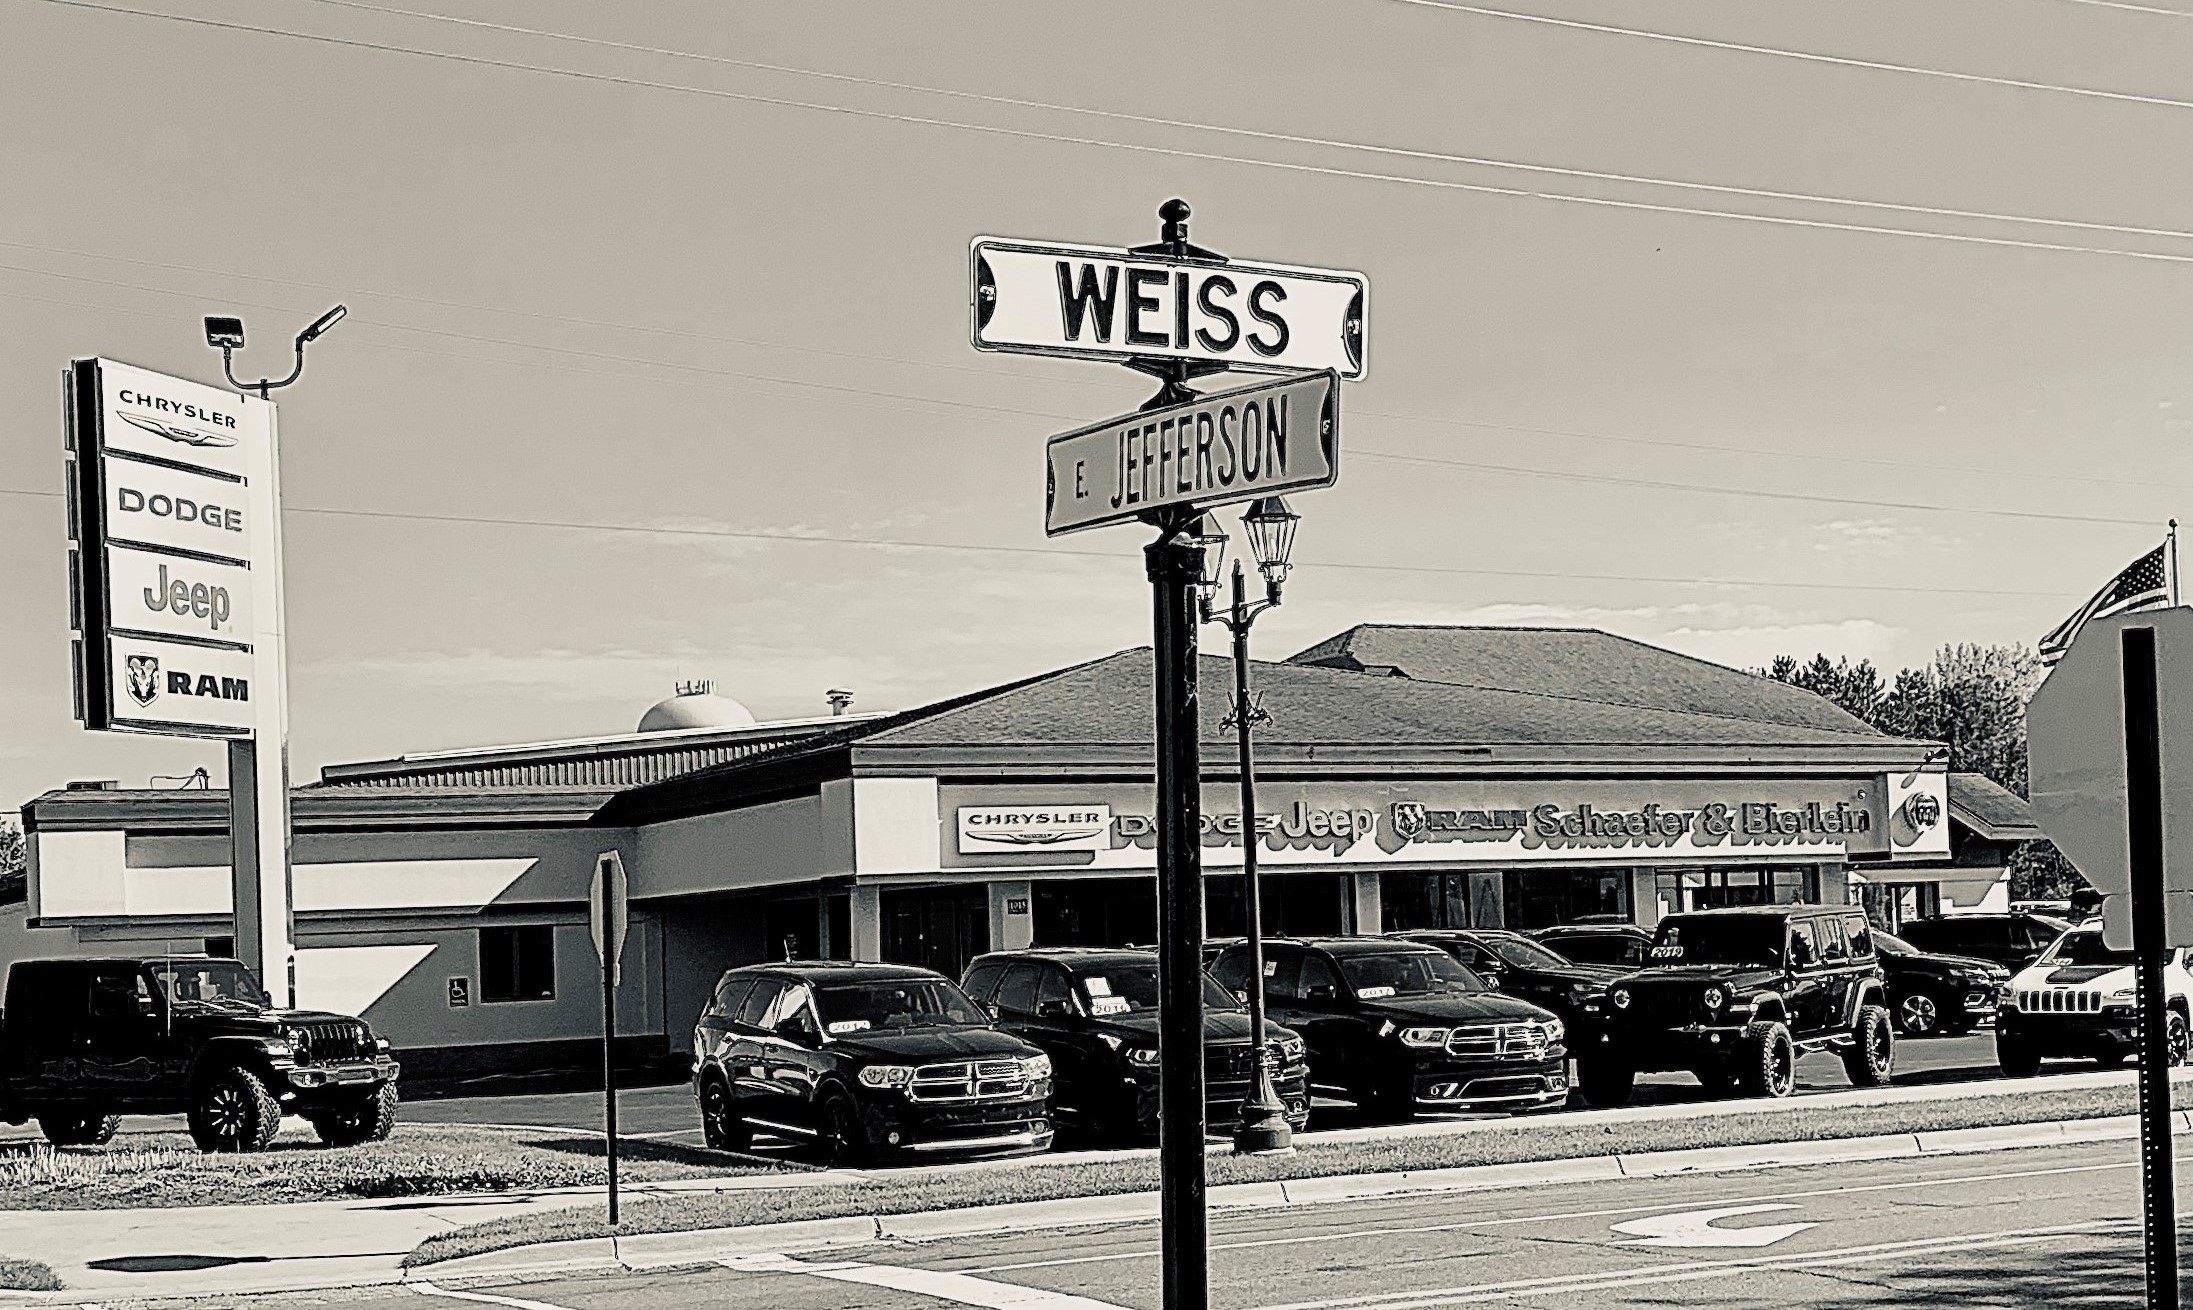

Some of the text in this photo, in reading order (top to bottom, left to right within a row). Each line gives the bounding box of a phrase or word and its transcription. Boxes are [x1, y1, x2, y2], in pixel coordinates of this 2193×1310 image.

[1055, 260, 1290, 357] WEISS
[118, 389, 237, 429] CHRYSLER
[1075, 394, 1288, 509] E. JEFFERSON
[118, 487, 243, 532] DODGE
[143, 564, 230, 630] Jeep
[167, 671, 249, 702] RAM
[968, 812, 1100, 825] CHRYSLER
[1117, 801, 1870, 841] DGE Jeep RAM Schaefer & Bierlein
